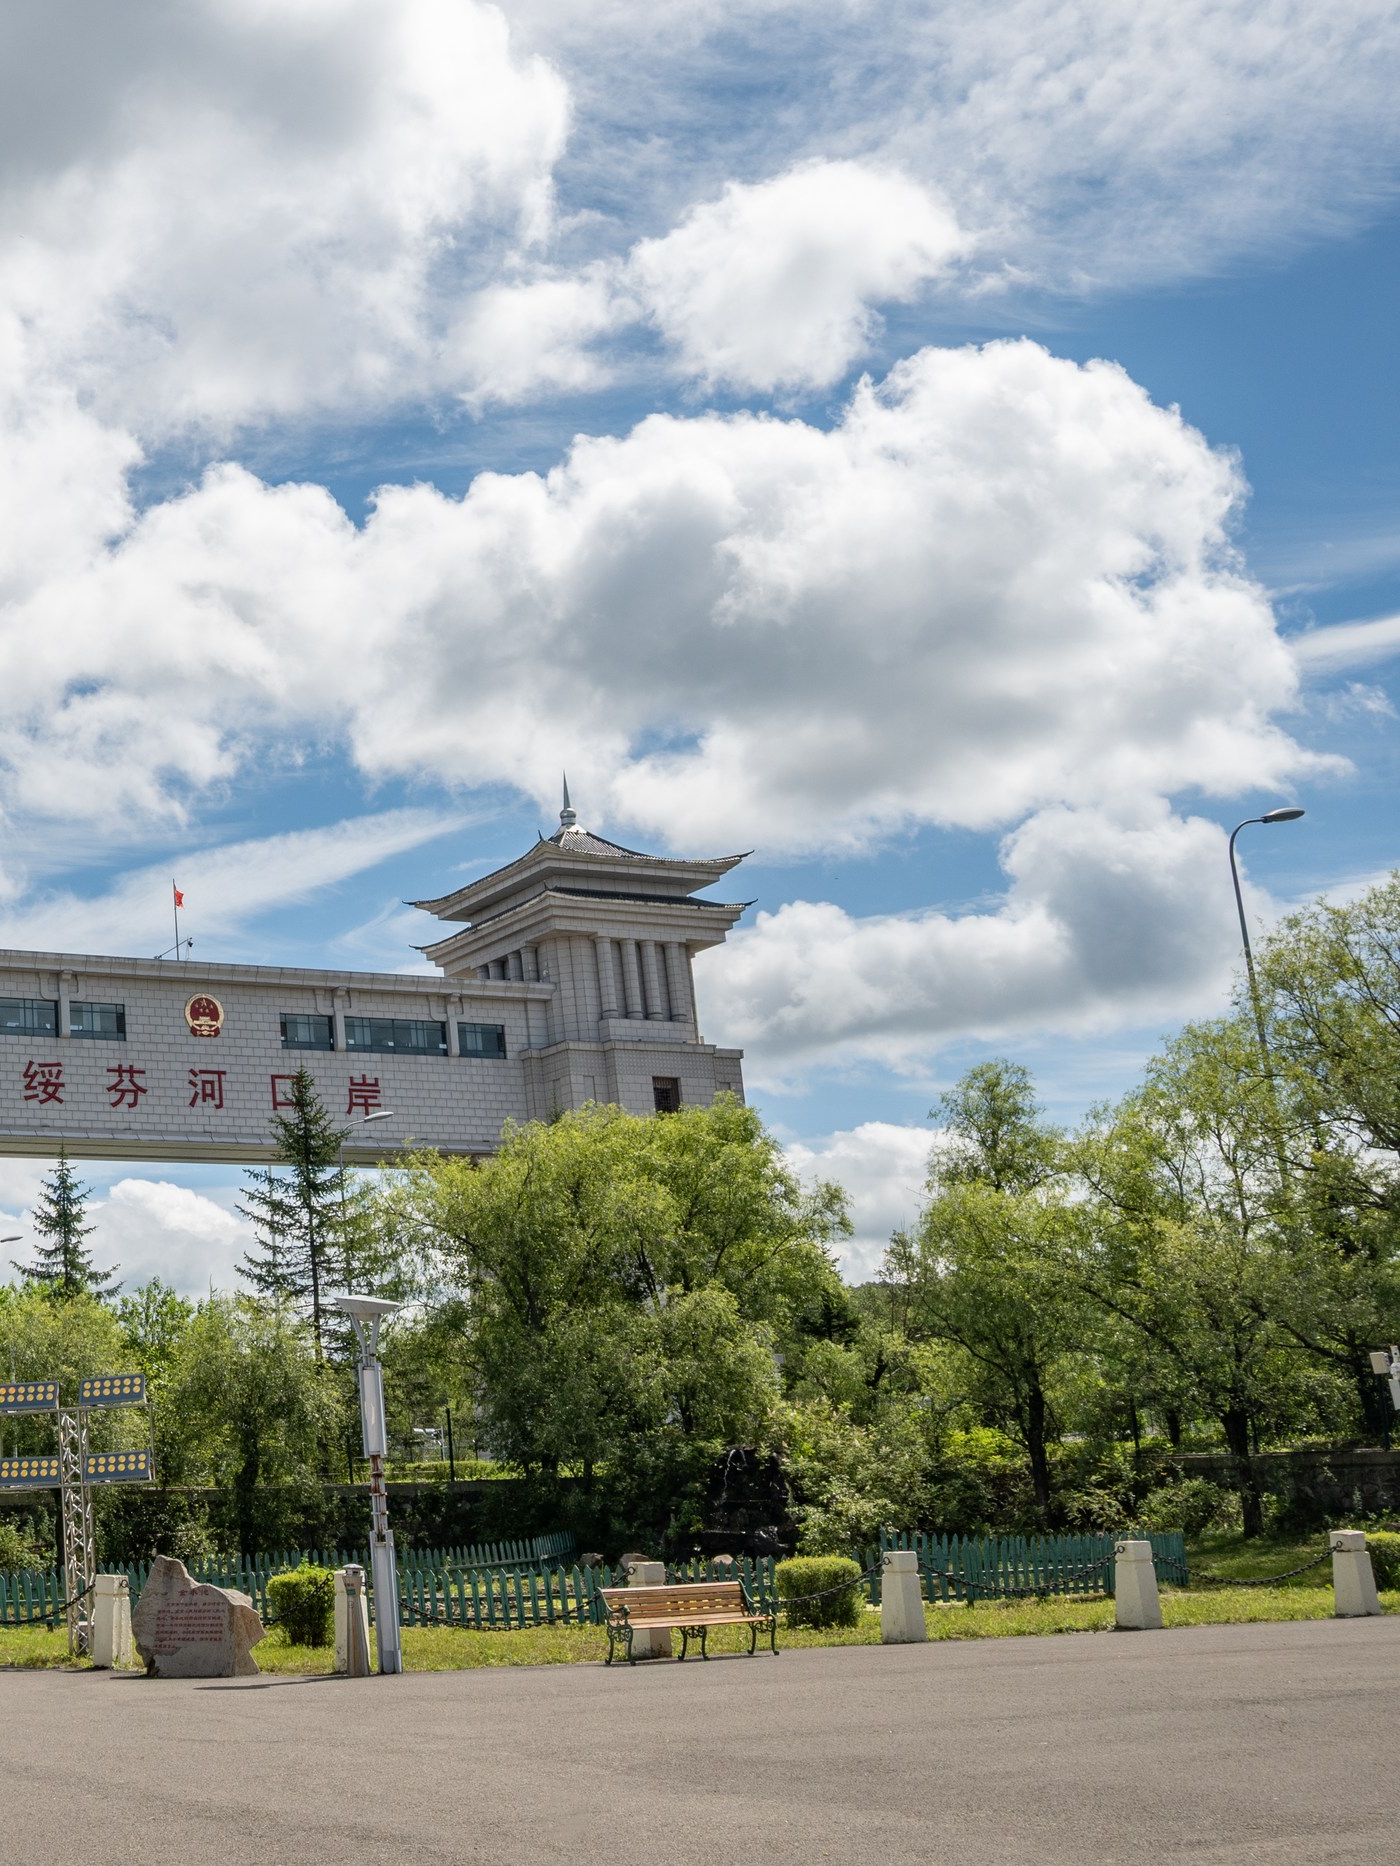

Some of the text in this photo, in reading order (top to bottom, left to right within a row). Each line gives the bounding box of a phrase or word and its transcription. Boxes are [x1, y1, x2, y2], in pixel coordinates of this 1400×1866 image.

[22, 1060, 382, 1115] 绥芬河口岸
